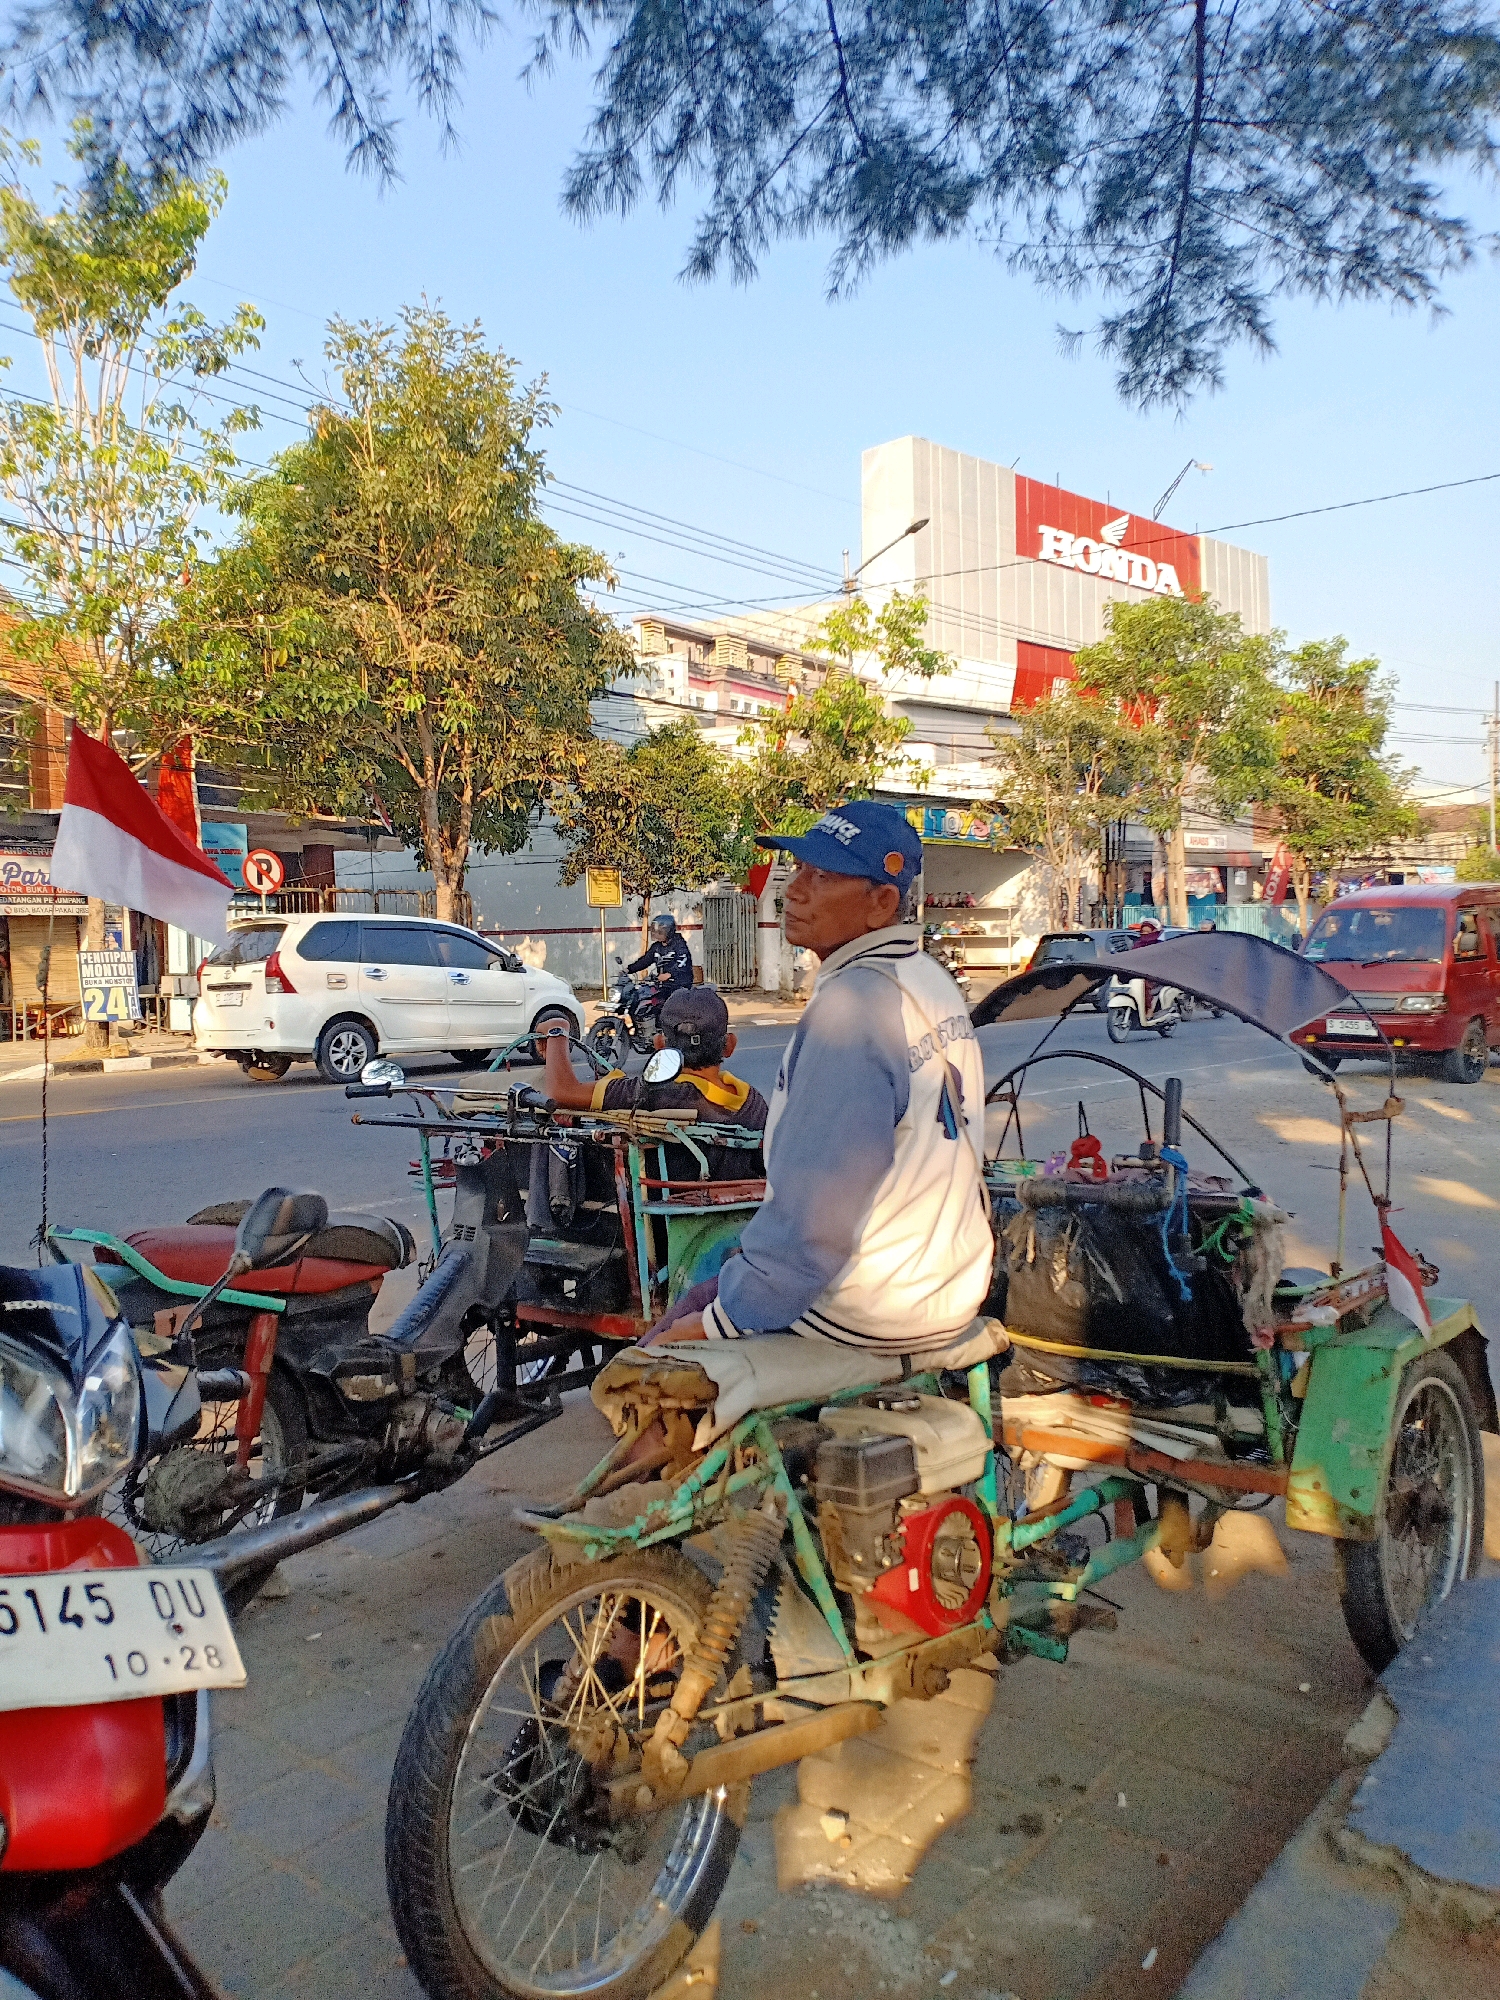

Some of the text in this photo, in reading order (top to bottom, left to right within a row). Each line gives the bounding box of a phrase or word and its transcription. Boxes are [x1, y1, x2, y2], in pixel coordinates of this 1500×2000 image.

[1038, 524, 1184, 597] HONDA
[929, 807, 990, 840] TOYS
[4, 847, 24, 856] AND
[26, 885, 48, 894] BUKA
[80, 951, 134, 964] PENITIPAN
[81, 963, 134, 978] MONTOR
[84, 986, 129, 1020] 24
[2, 1299, 79, 1316] HONDA
[147, 1578, 206, 1622] DU
